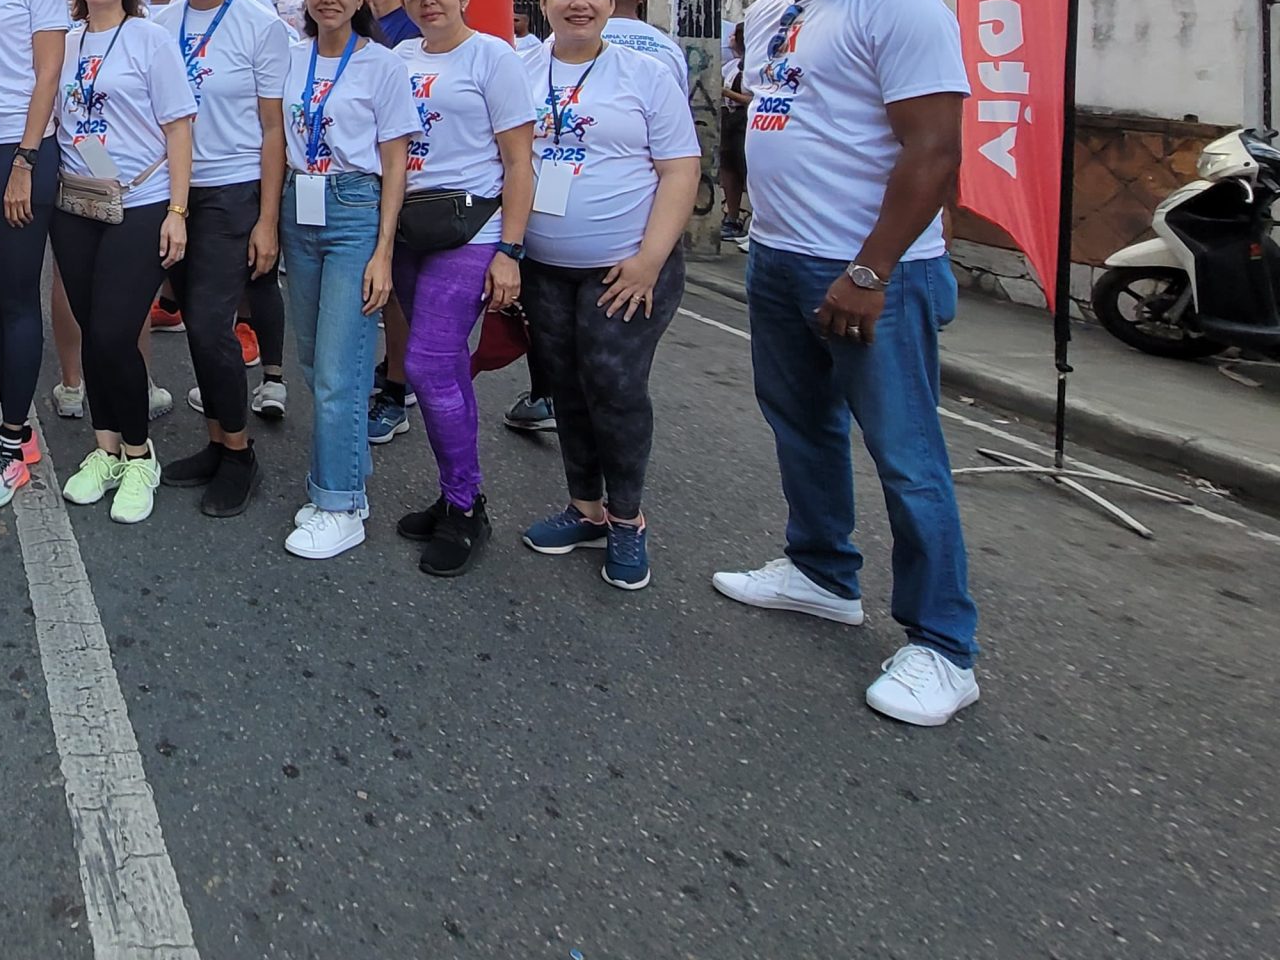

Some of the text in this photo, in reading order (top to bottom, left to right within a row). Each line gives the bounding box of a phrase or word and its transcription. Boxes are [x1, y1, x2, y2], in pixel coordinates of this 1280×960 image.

[757, 97, 794, 114] 2025
[75, 120, 108, 135] 2025
[751, 114, 789, 131] RUN
[407, 140, 430, 157] 025
[542, 147, 586, 161] 2025
[406, 157, 425, 171] UN
